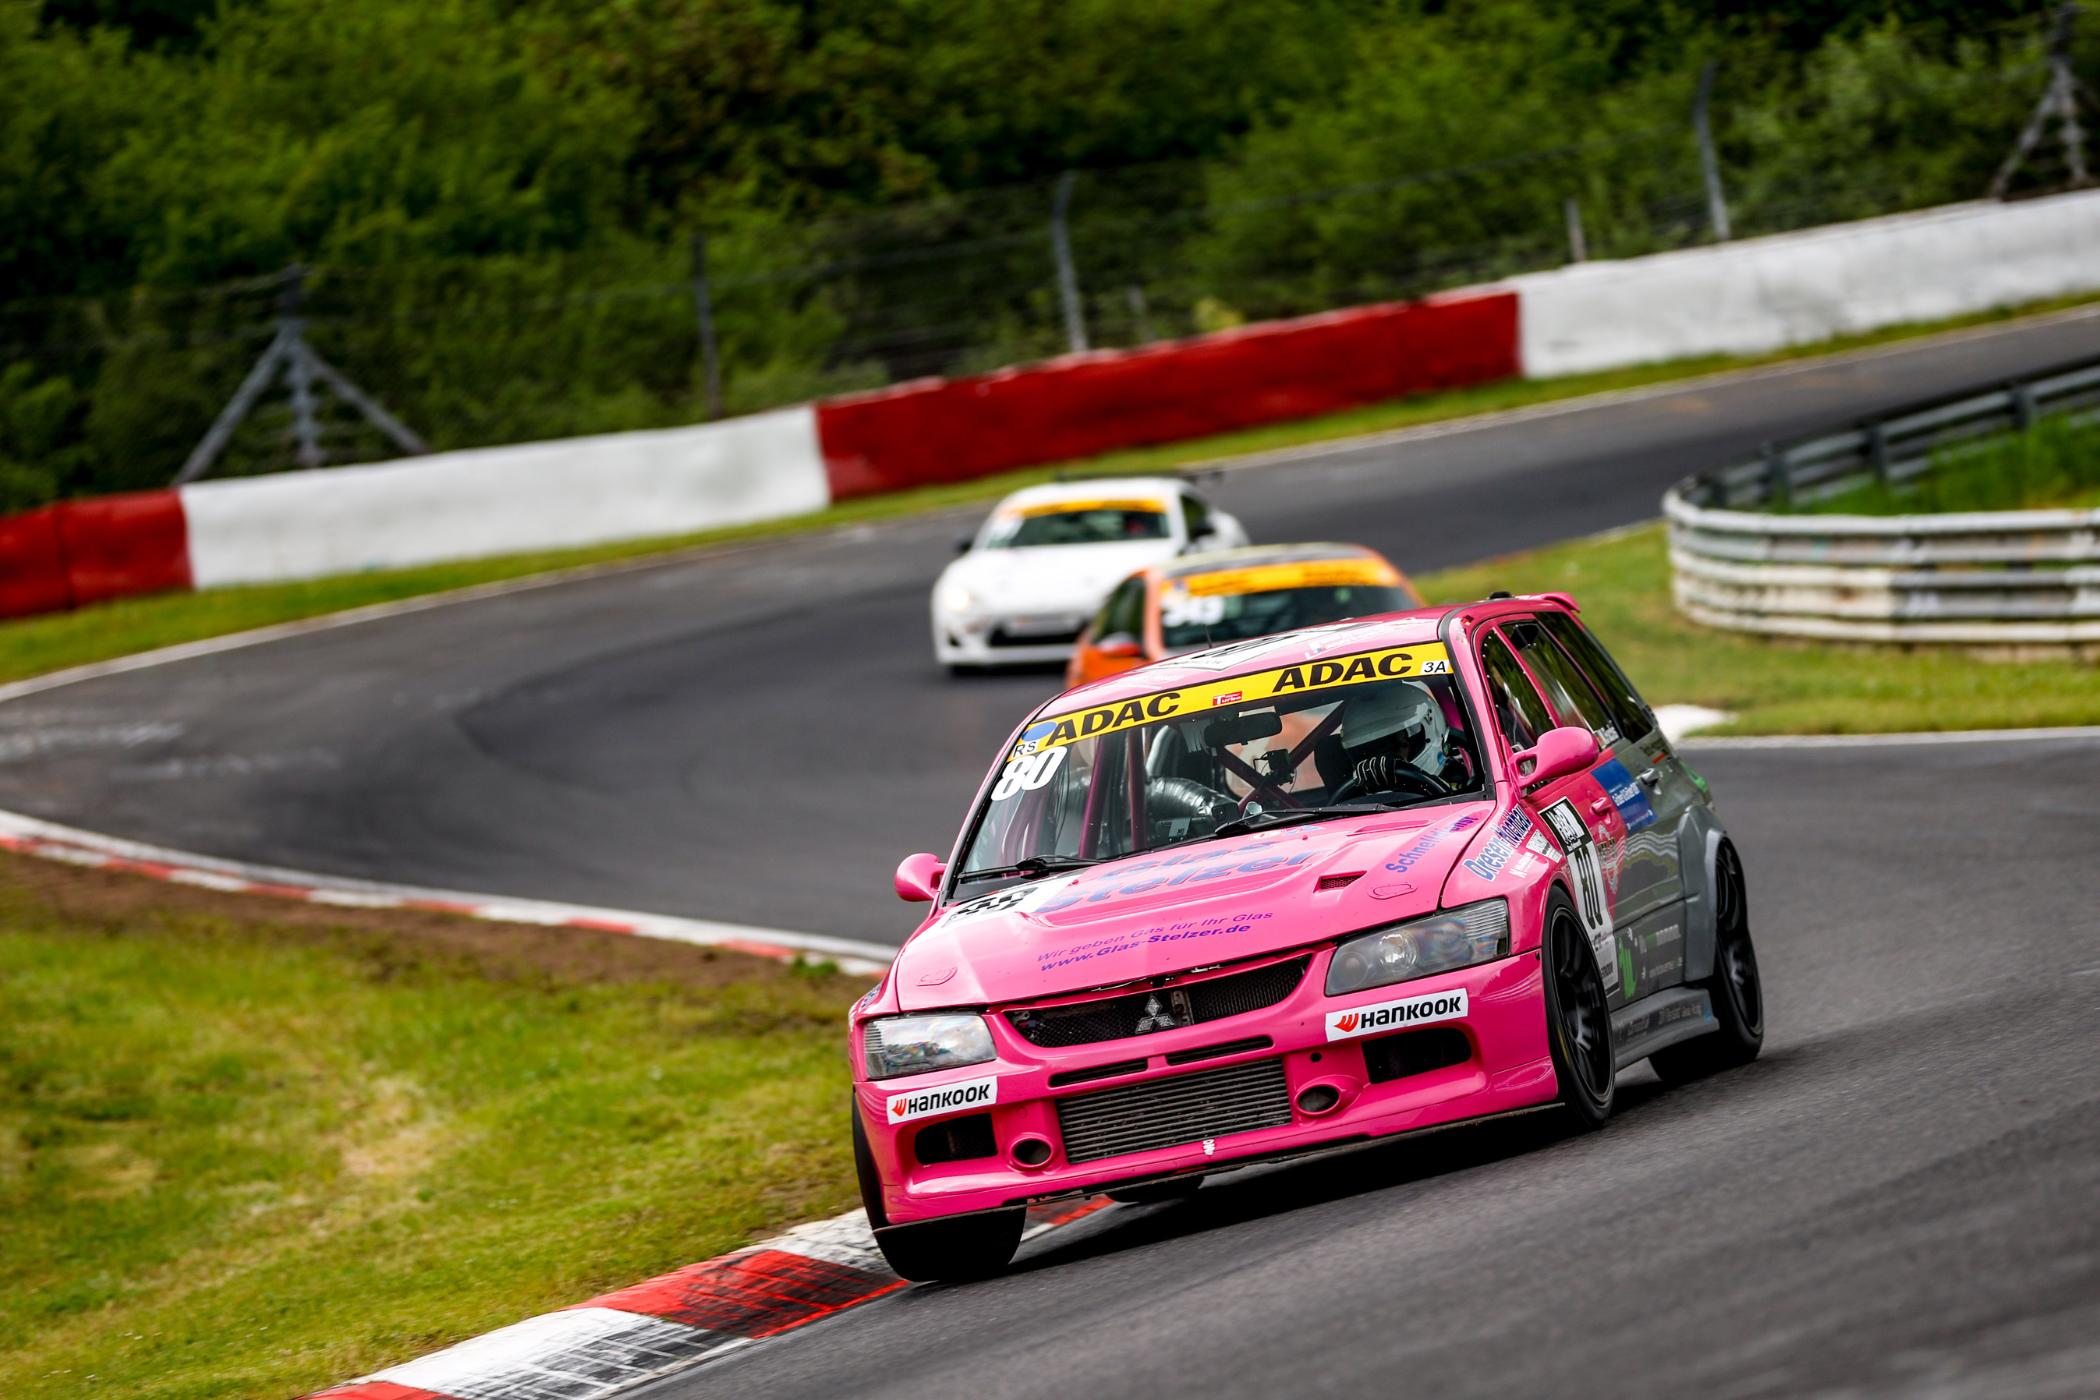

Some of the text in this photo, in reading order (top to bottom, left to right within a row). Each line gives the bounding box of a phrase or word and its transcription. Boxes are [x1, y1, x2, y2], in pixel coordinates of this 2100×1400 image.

[1272, 652, 1449, 693] ADAC 3A
[1046, 692, 1181, 747] ADAC
[990, 745, 1068, 802] 80
[1013, 741, 1037, 758] RS
[1035, 849, 1325, 913] Stelzer
[1099, 841, 1276, 881] Glas
[1037, 912, 1274, 962] Wir geben Gas für Ihr Glas
[1040, 924, 1251, 972] www.Glas-Stelzer.de
